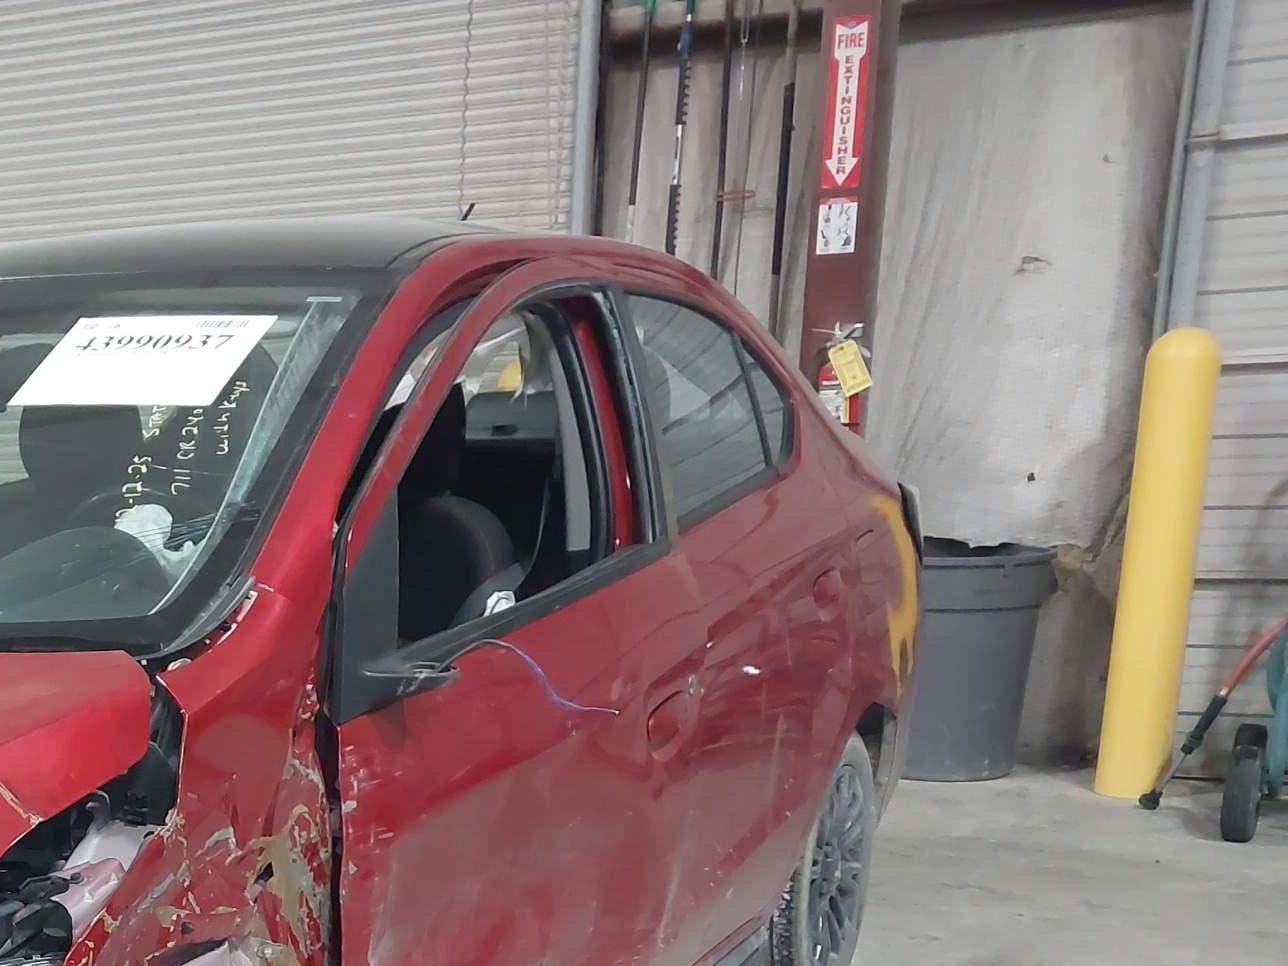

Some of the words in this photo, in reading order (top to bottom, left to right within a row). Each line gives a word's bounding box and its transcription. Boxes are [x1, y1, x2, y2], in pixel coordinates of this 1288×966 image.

[837, 32, 865, 50] FIRE
[835, 55, 856, 175] EXTINGUISHER
[75, 335, 236, 351] 43990937
[171, 468, 192, 495] 711
